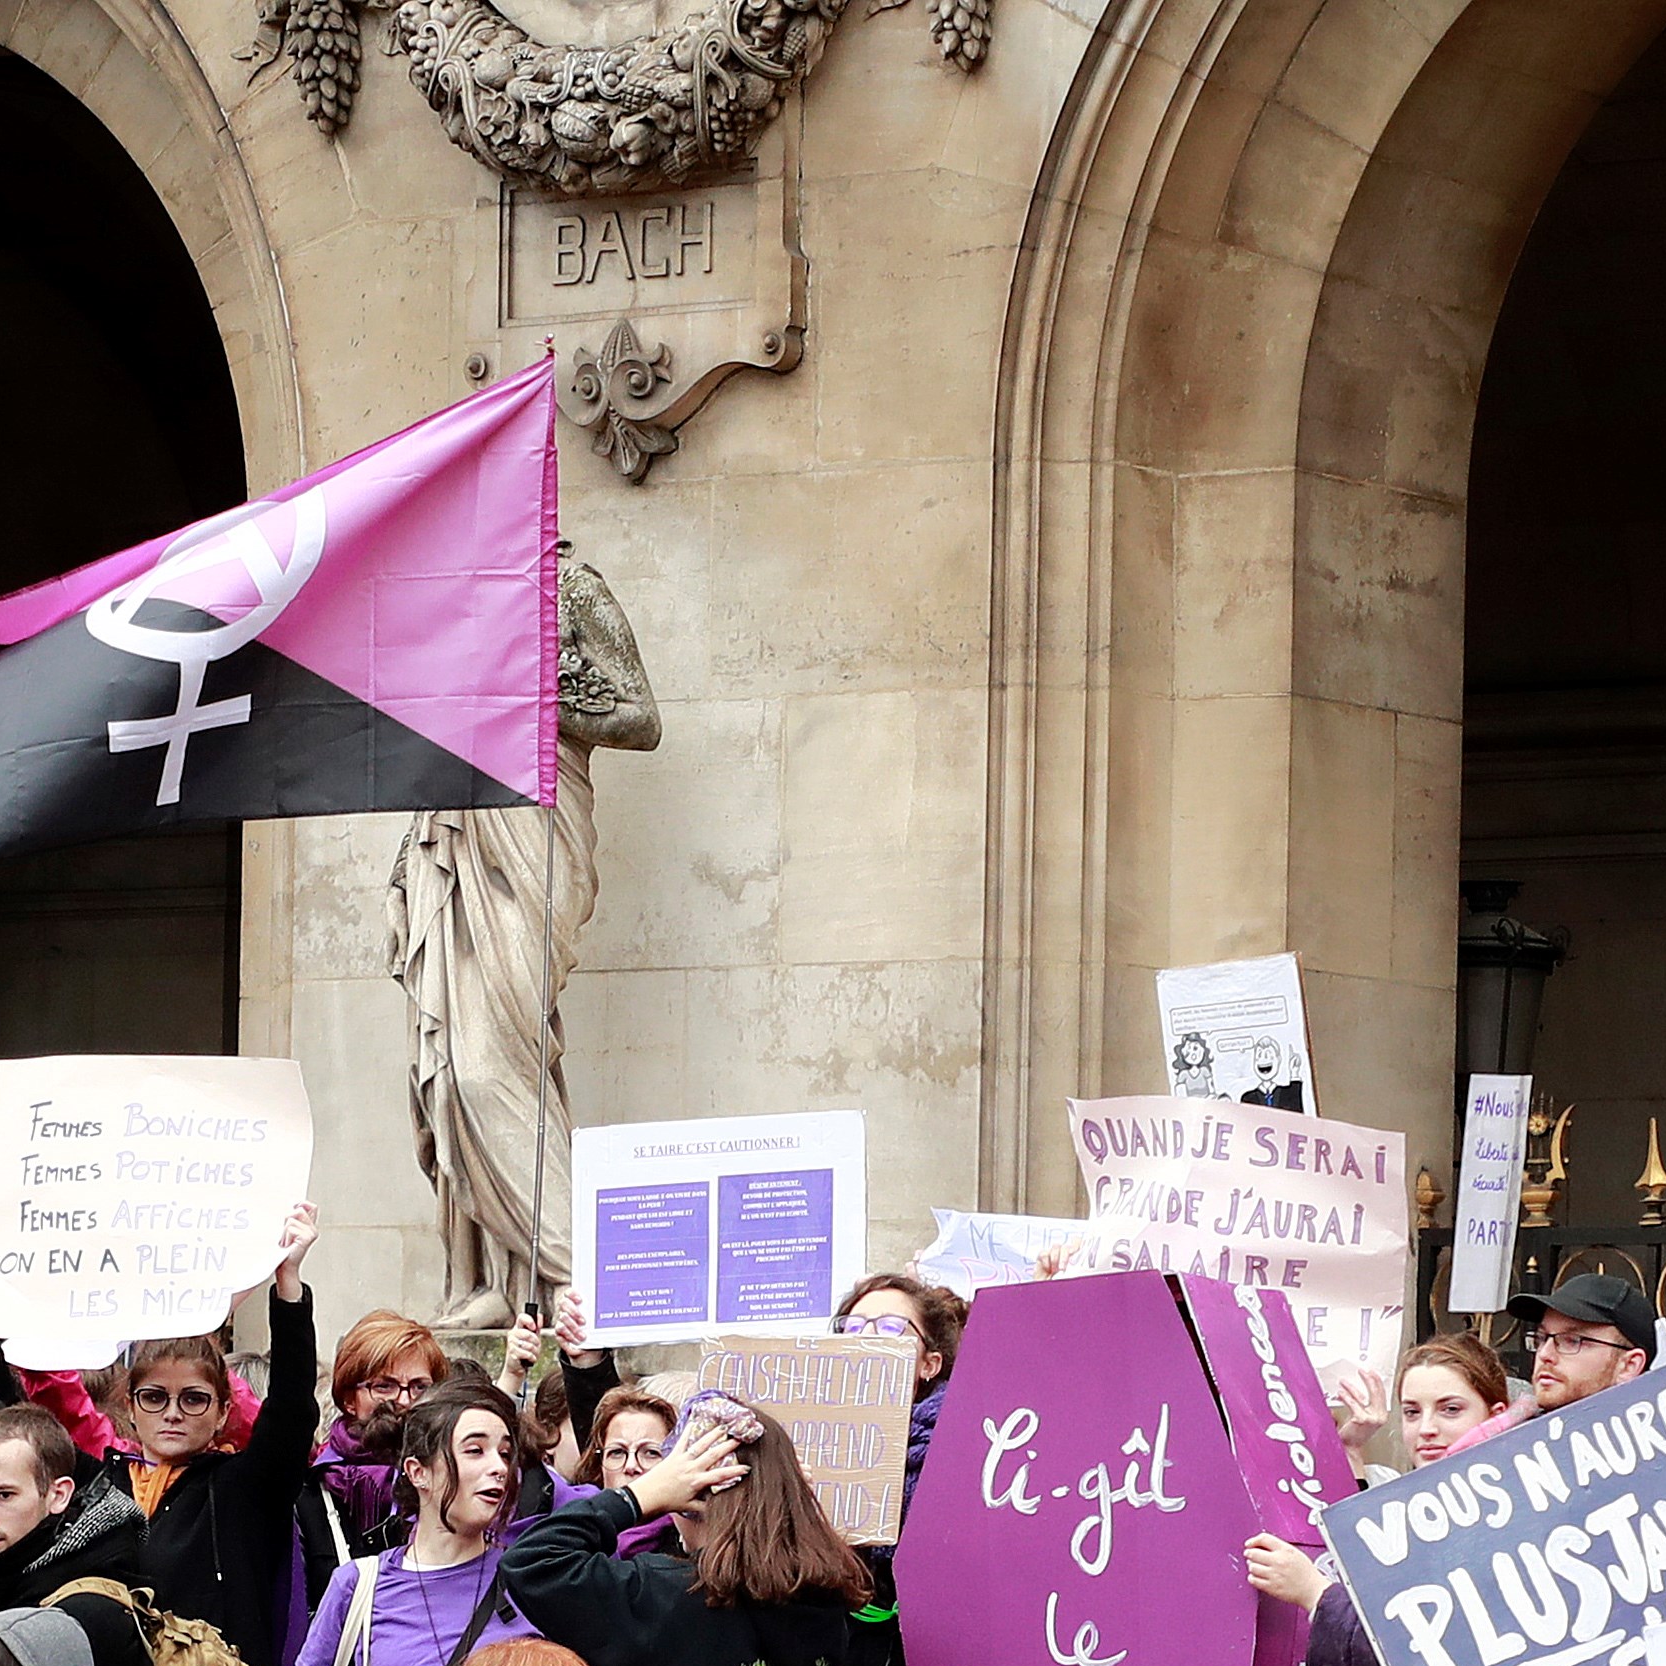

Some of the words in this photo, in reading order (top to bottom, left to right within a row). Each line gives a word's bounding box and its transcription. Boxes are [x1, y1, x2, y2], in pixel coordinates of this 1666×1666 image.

[552, 202, 714, 286] BACH
[633, 1147, 648, 1158] SE
[649, 1144, 684, 1157] TAIRE
[686, 1141, 717, 1155] C'EST
[719, 1136, 793, 1152] CAUTIONNER
[1081, 1116, 1185, 1165] QUAND
[1190, 1115, 1235, 1161] JE
[1248, 1124, 1389, 1186] SERAI
[1213, 1186, 1367, 1247] J'AURAI
[0, 1251, 36, 1275] ON
[48, 1248, 83, 1275] EN
[99, 1248, 121, 1273] A
[69, 1289, 119, 1319] LES
[1355, 1463, 1514, 1567] VOUS
